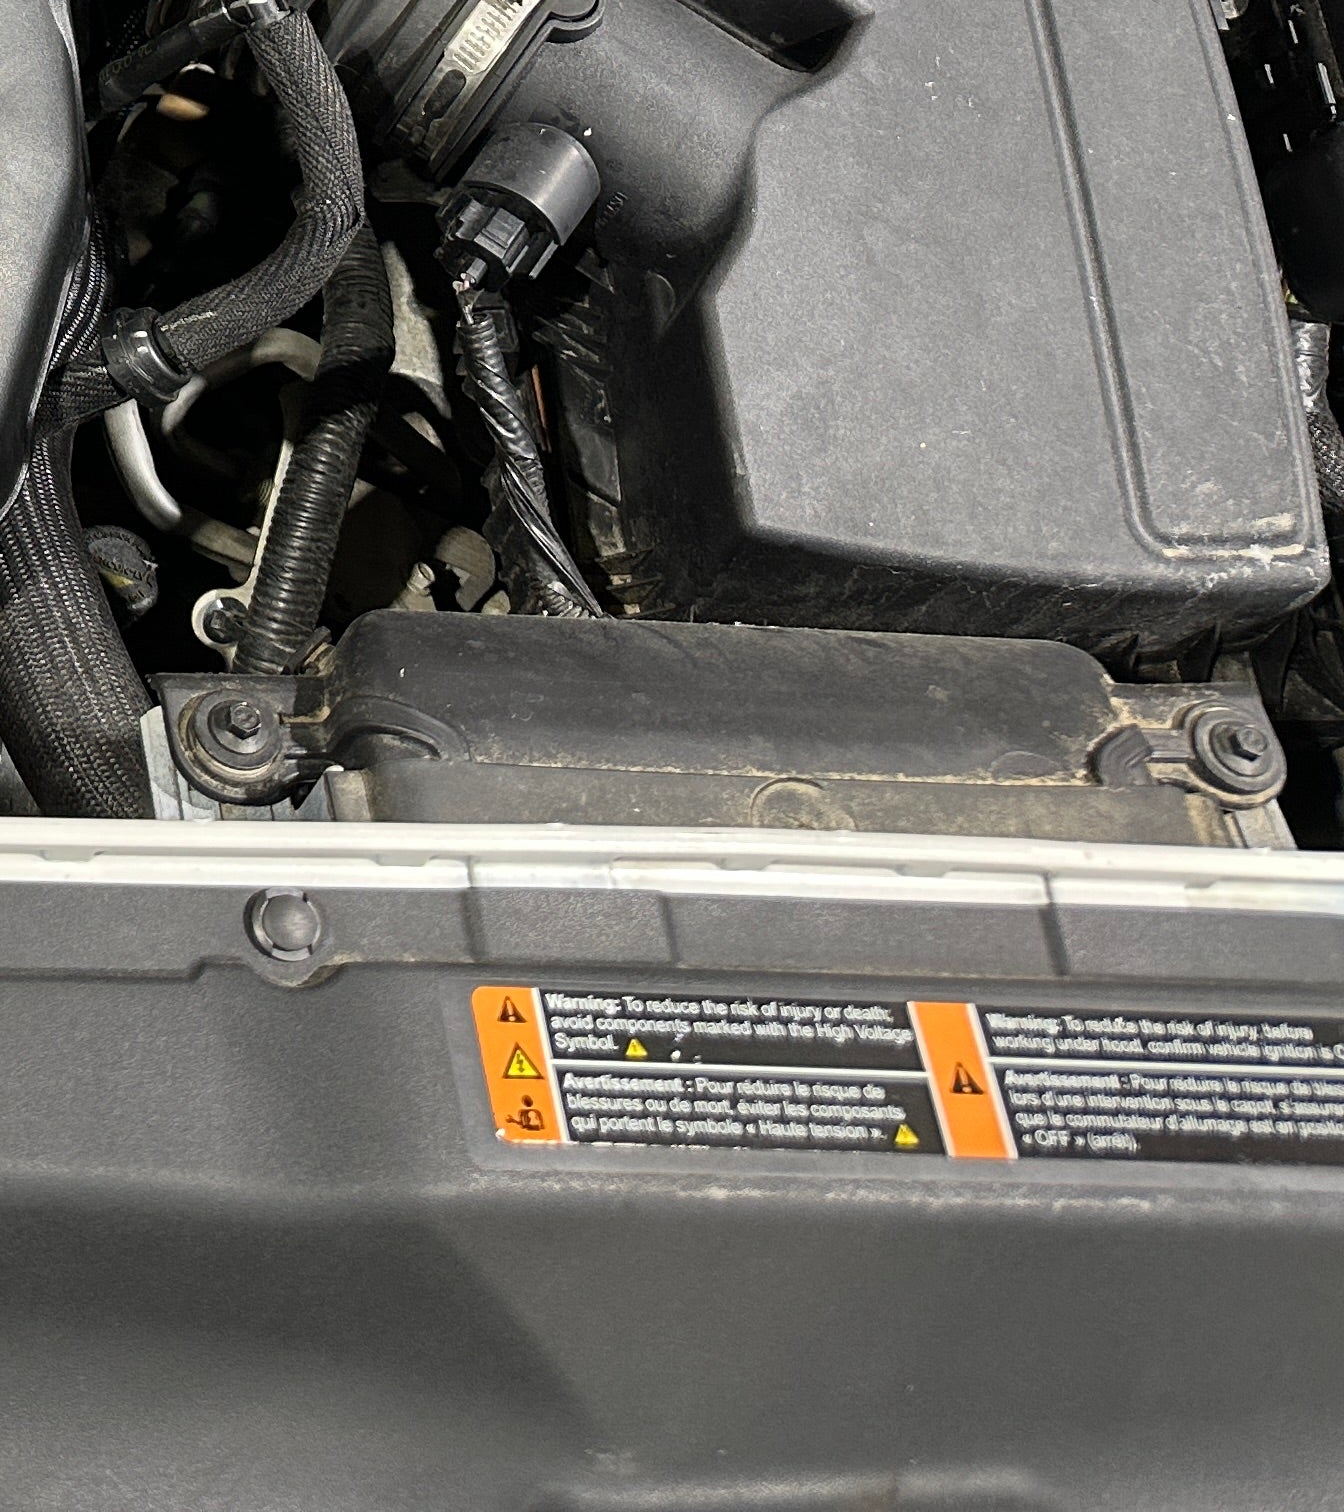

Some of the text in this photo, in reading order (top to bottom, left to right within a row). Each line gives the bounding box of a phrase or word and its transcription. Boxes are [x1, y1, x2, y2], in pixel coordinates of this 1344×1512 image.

[622, 995, 644, 1012] To
[646, 998, 700, 1014] reduce
[701, 999, 728, 1015] the
[730, 1000, 758, 1016] risk
[761, 1001, 778, 1016] of
[780, 1002, 821, 1021] injury
[824, 1006, 841, 1019] or
[550, 1014, 914, 1044] avoid components marked with the High Voltage
[1061, 1015, 1085, 1031] To
[1085, 1017, 1139, 1033] reduce
[1139, 1018, 1166, 1034] the
[1167, 1019, 1194, 1035] risk
[1196, 1020, 1213, 1036] of
[554, 1032, 619, 1052] Symbol.
[992, 1035, 1055, 1053] working
[1055, 1037, 1100, 1051] under
[1148, 1039, 1206, 1055] confirm
[1206, 1041, 1261, 1058] vehicle
[563, 1073, 684, 1092] Avertissement
[695, 1077, 734, 1093] Pour
[736, 1079, 793, 1096] réduire
[793, 1081, 810, 1097] le
[813, 1082, 862, 1101] risque
[863, 1083, 886, 1099] de
[1130, 1074, 1168, 1090] Pour
[566, 1093, 644, 1111] blessures
[645, 1099, 668, 1112] ou
[669, 1097, 692, 1112] de
[782, 1100, 810, 1116] les
[810, 1104, 907, 1121] composants
[1009, 1090, 1041, 1106] lors
[1085, 1094, 1174, 1109] intervention
[1174, 1097, 1213, 1111] sous
[571, 1114, 598, 1133] qui
[599, 1116, 656, 1133] portent
[656, 1117, 674, 1133] le
[675, 1118, 743, 1136] symbole
[758, 1119, 809, 1136] Haute
[808, 1122, 869, 1138] tension
[1015, 1112, 1047, 1129] que
[1047, 1111, 1065, 1127] le
[1065, 1113, 1163, 1129] commutateur
[1034, 1130, 1070, 1146] OFF
